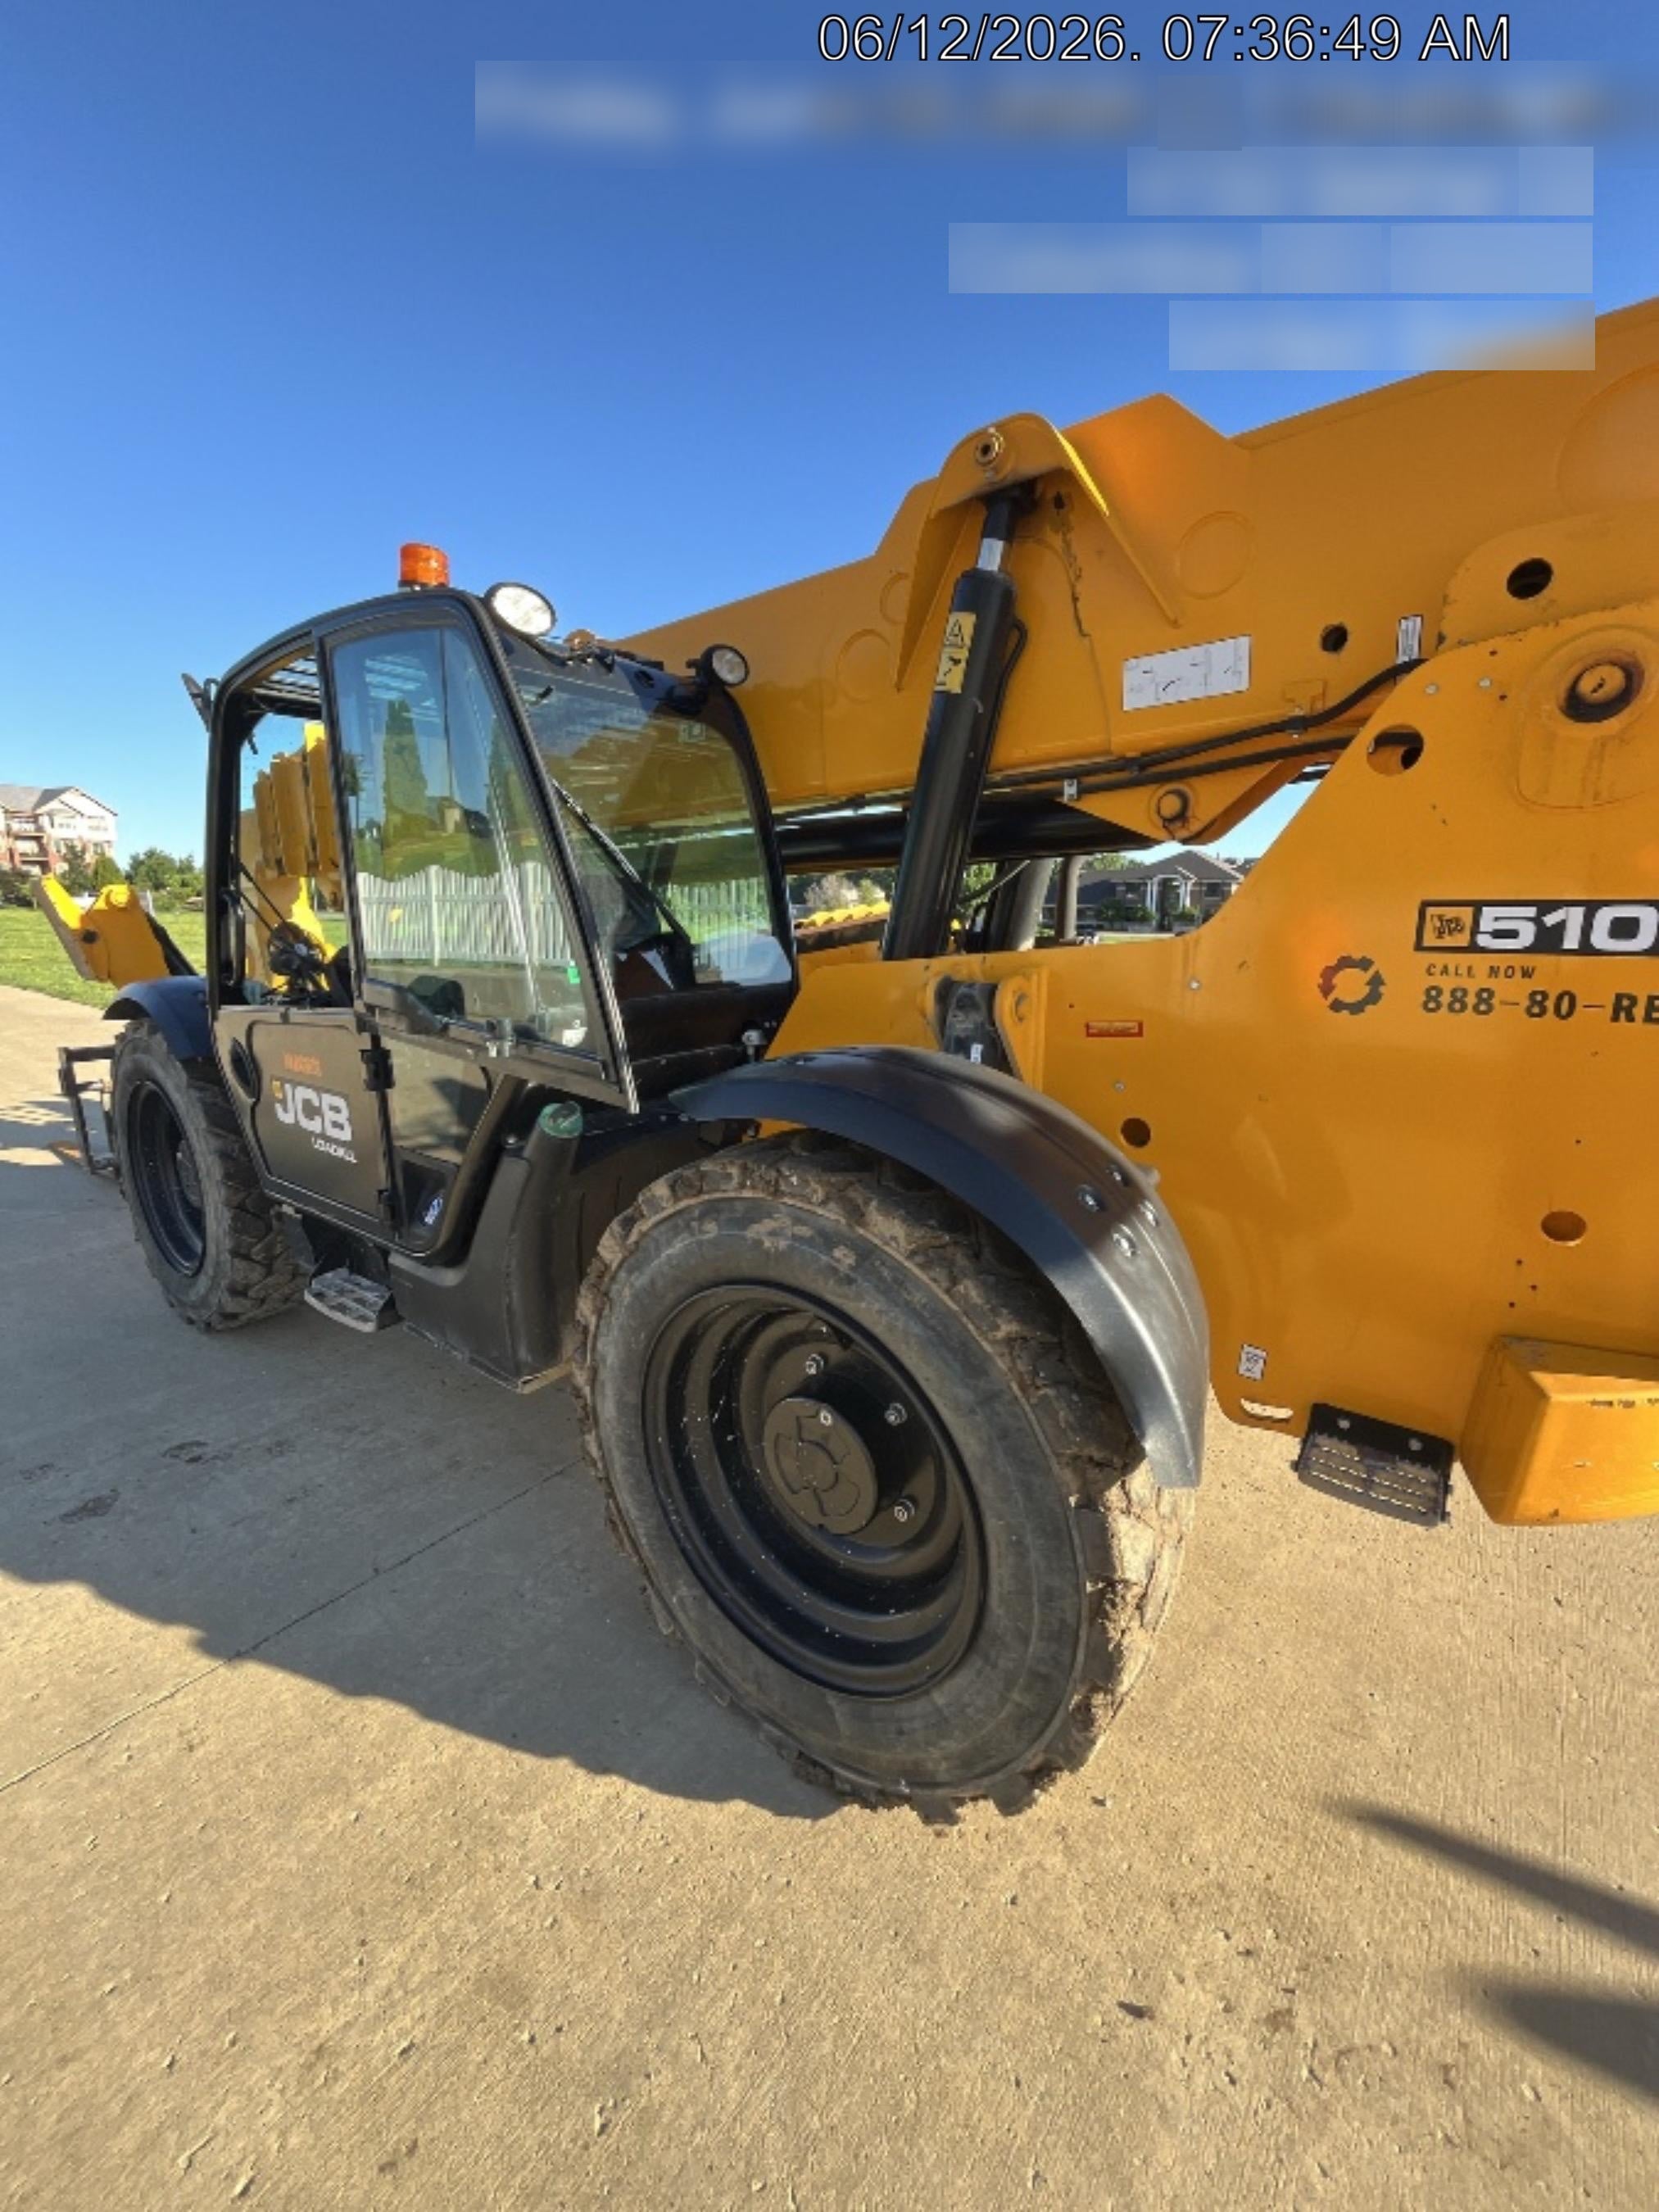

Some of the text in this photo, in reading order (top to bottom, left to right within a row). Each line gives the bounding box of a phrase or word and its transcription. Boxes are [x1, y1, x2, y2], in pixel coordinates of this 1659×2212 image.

[1475, 904, 1658, 951] 510
[1426, 963, 1537, 980] CALL NOW
[274, 1083, 352, 1141] JCB
